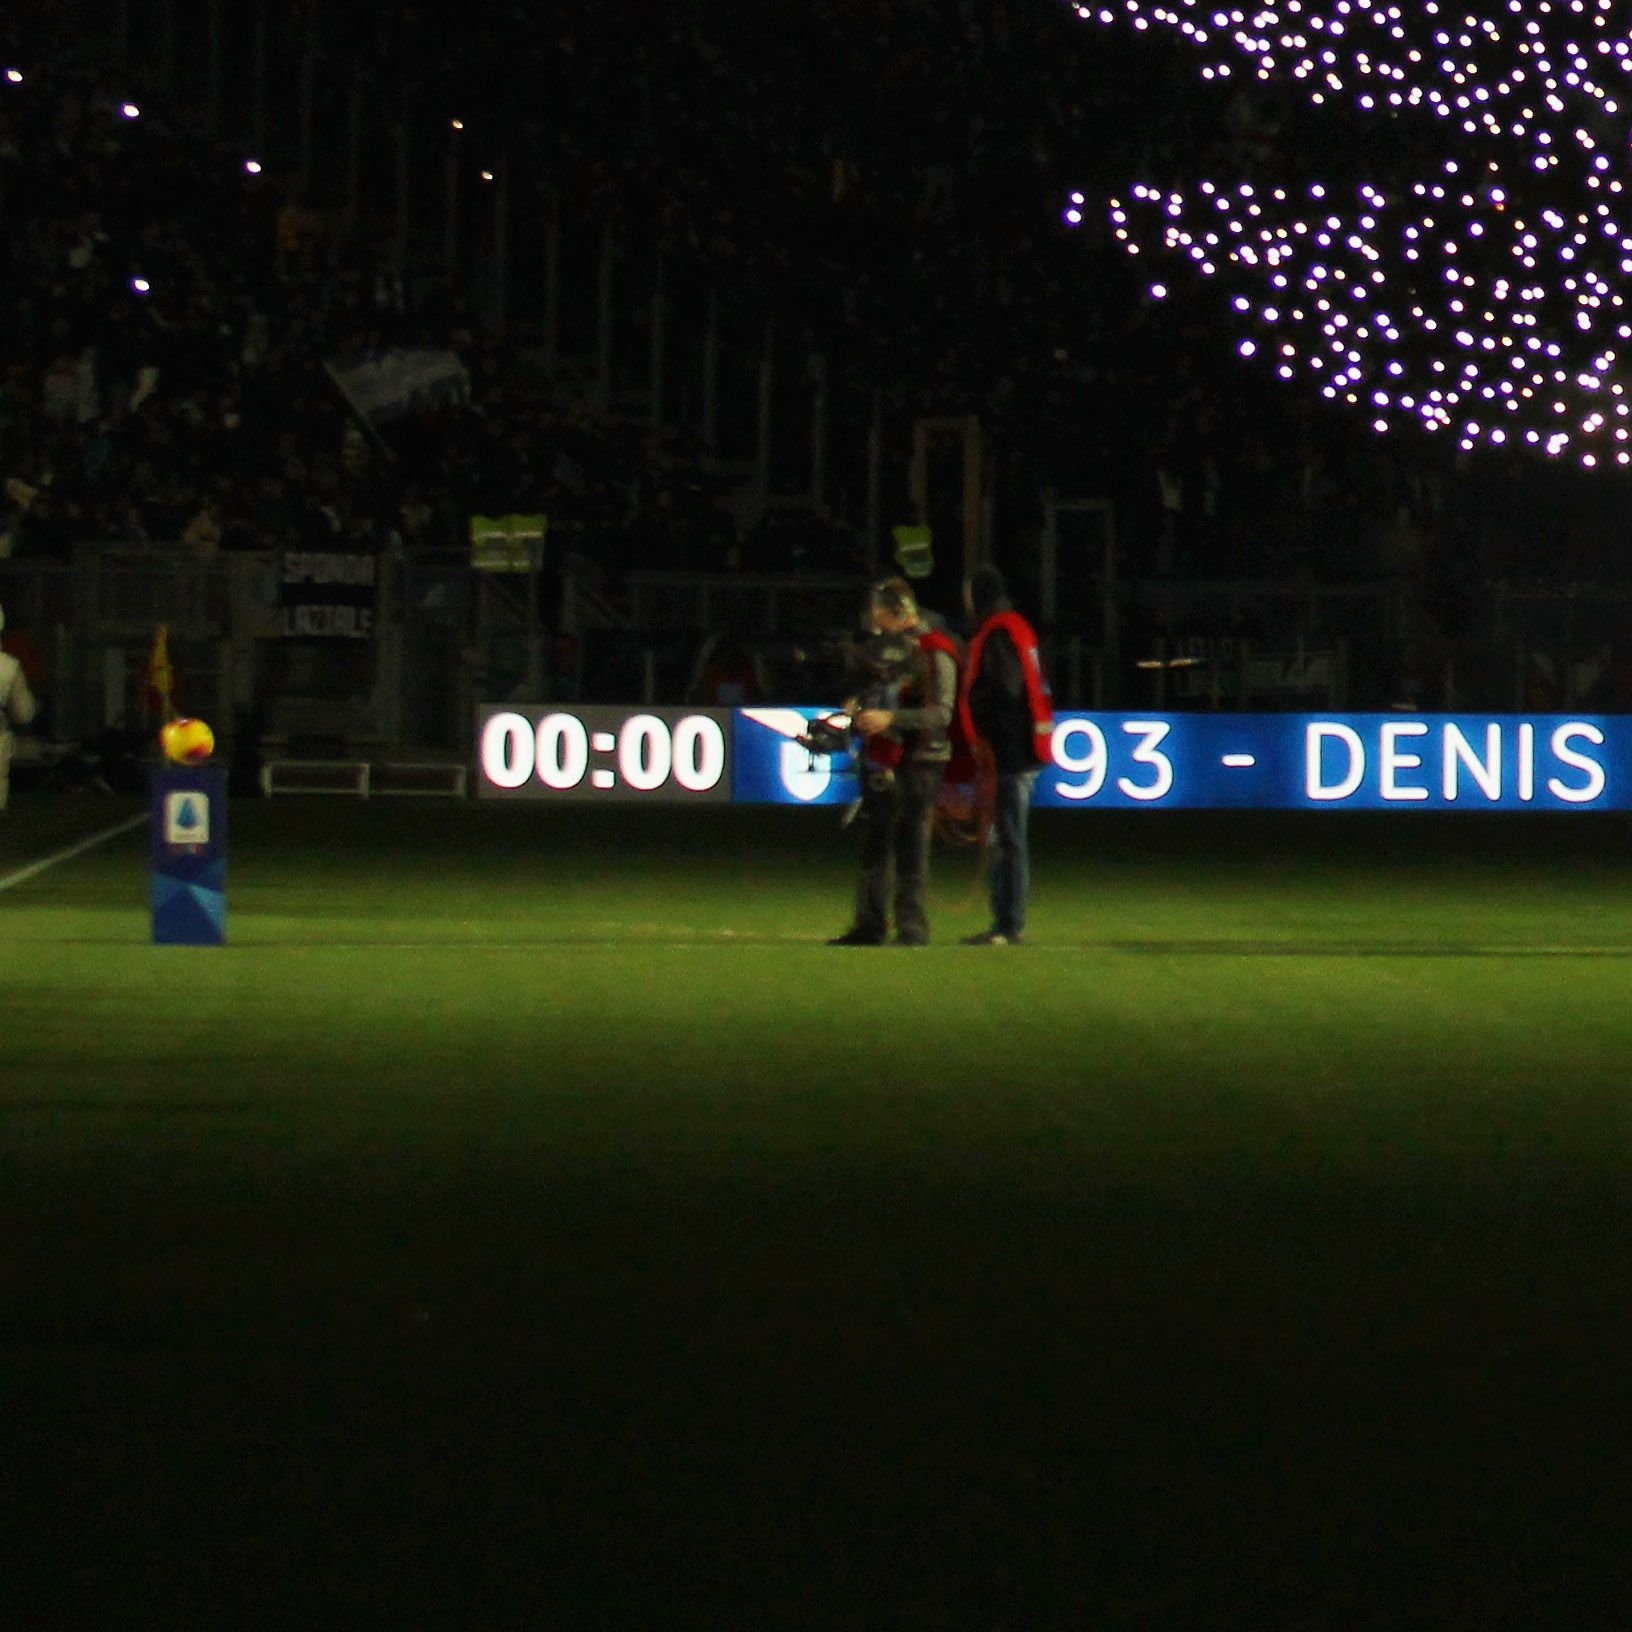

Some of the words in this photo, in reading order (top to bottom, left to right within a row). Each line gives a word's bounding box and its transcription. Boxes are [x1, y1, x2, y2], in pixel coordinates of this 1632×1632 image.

[481, 712, 726, 791] 00:00
[1050, 717, 1174, 801] 93
[1222, 753, 1257, 768] -
[1304, 721, 1607, 804] DENIS
